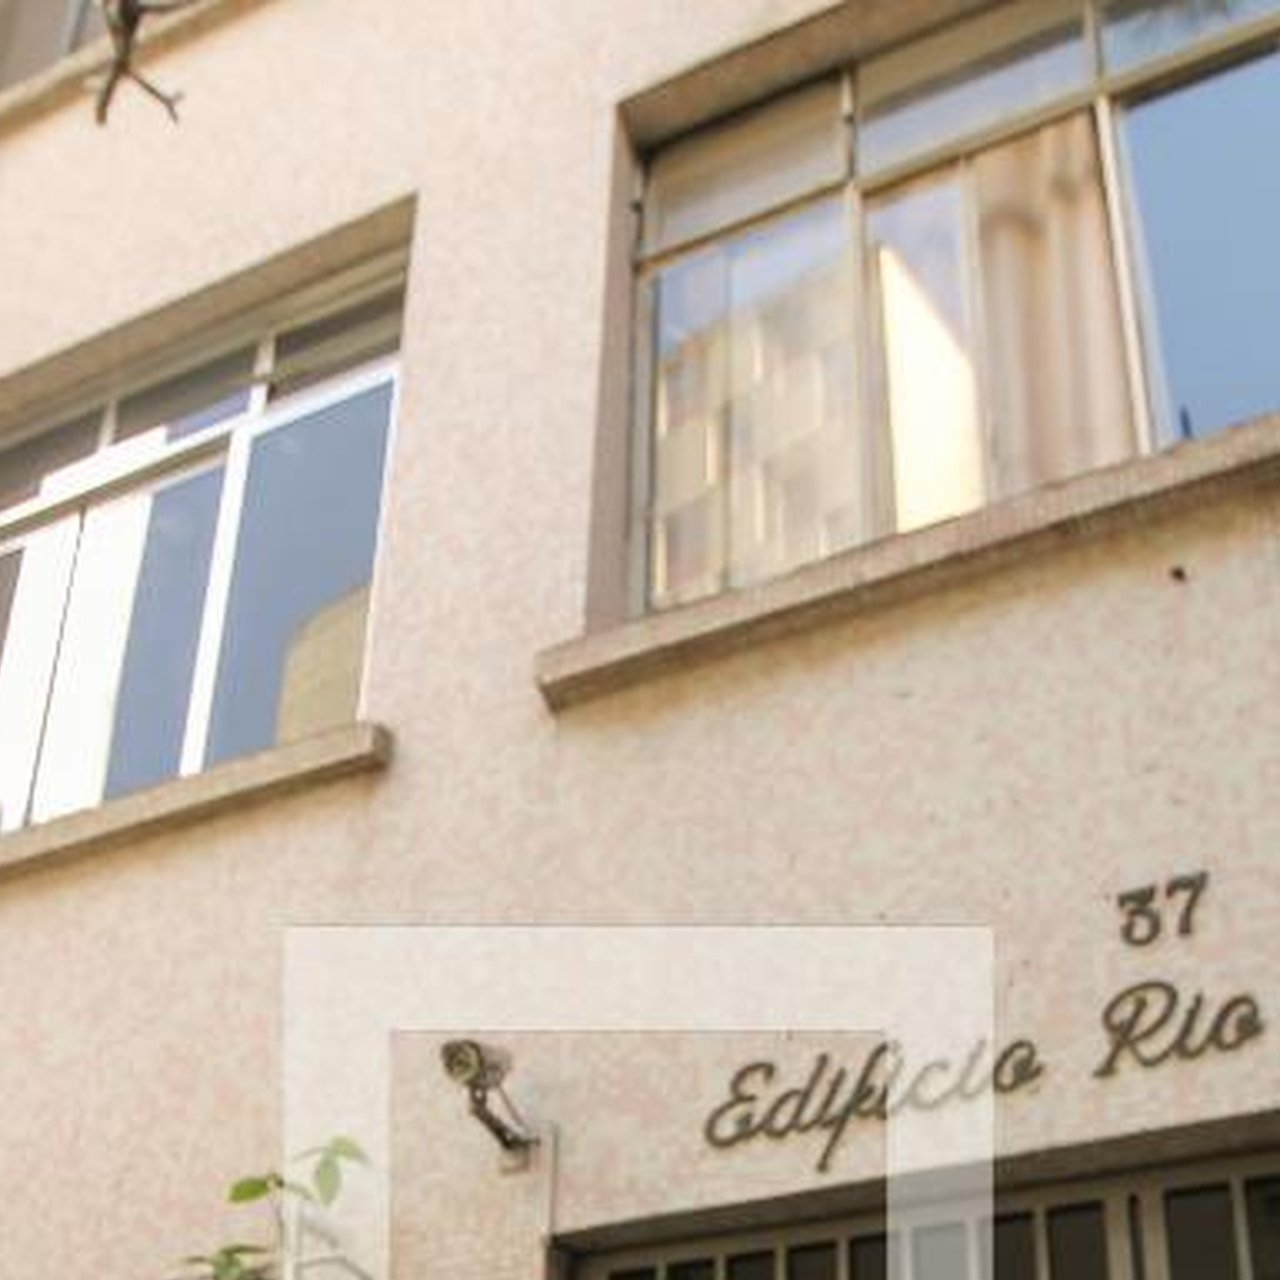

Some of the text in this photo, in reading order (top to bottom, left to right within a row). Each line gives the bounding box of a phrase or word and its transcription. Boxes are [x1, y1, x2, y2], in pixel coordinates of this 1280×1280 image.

[1117, 871, 1209, 947] 37
[704, 1038, 1044, 1174] Edificio
[1093, 980, 1265, 1079] Rio
